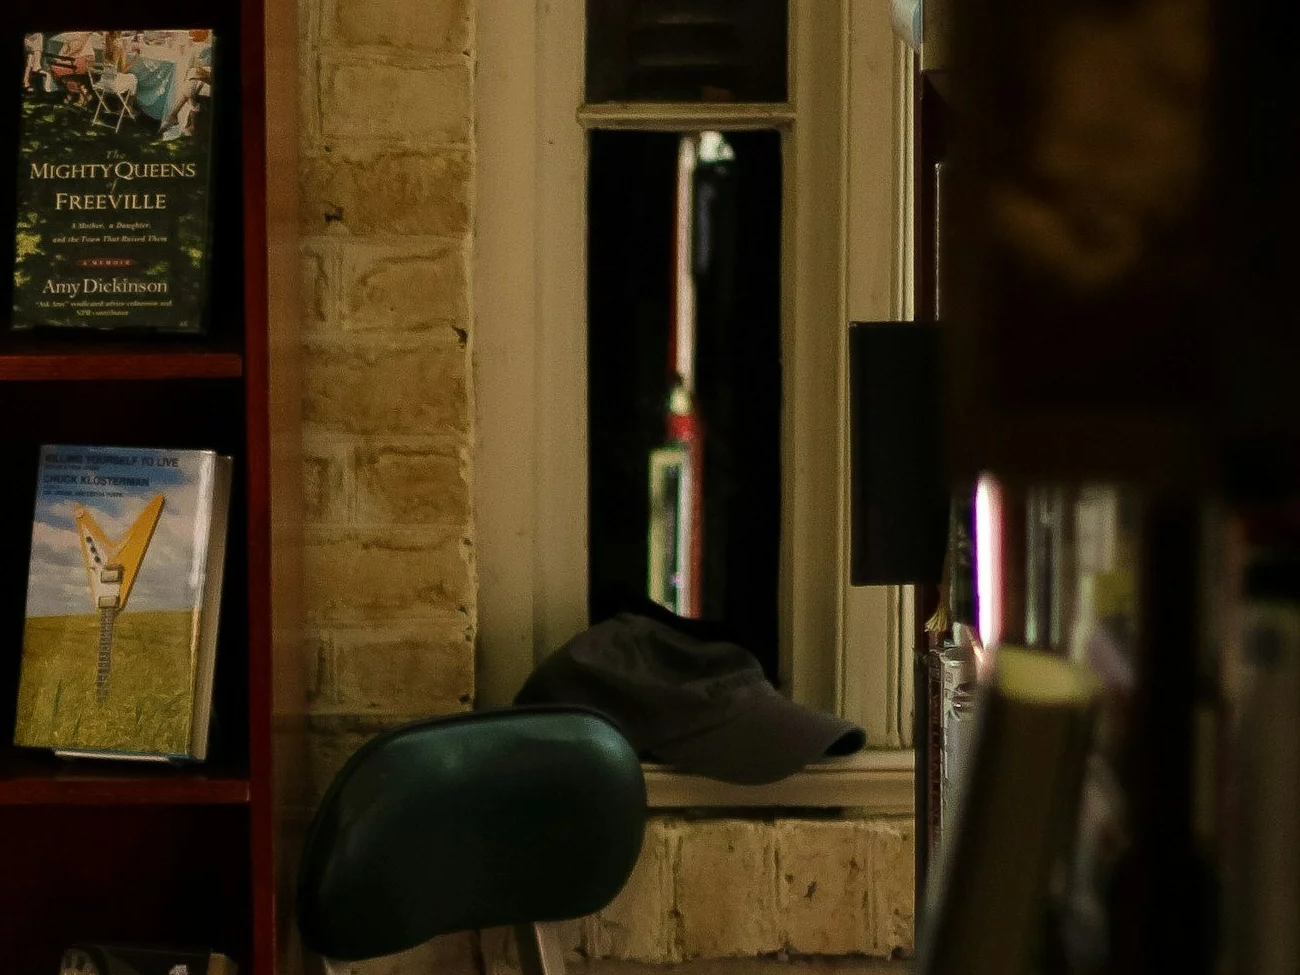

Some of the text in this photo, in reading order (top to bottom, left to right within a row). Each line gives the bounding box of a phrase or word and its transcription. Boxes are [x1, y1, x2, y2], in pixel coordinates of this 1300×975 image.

[30, 161, 196, 180] MIGHTY QUEENS
[55, 192, 167, 210] FREEVILLE
[42, 277, 167, 299] Amy Dickinson
[157, 457, 180, 467] LIVE
[43, 475, 77, 485] CHUCK
